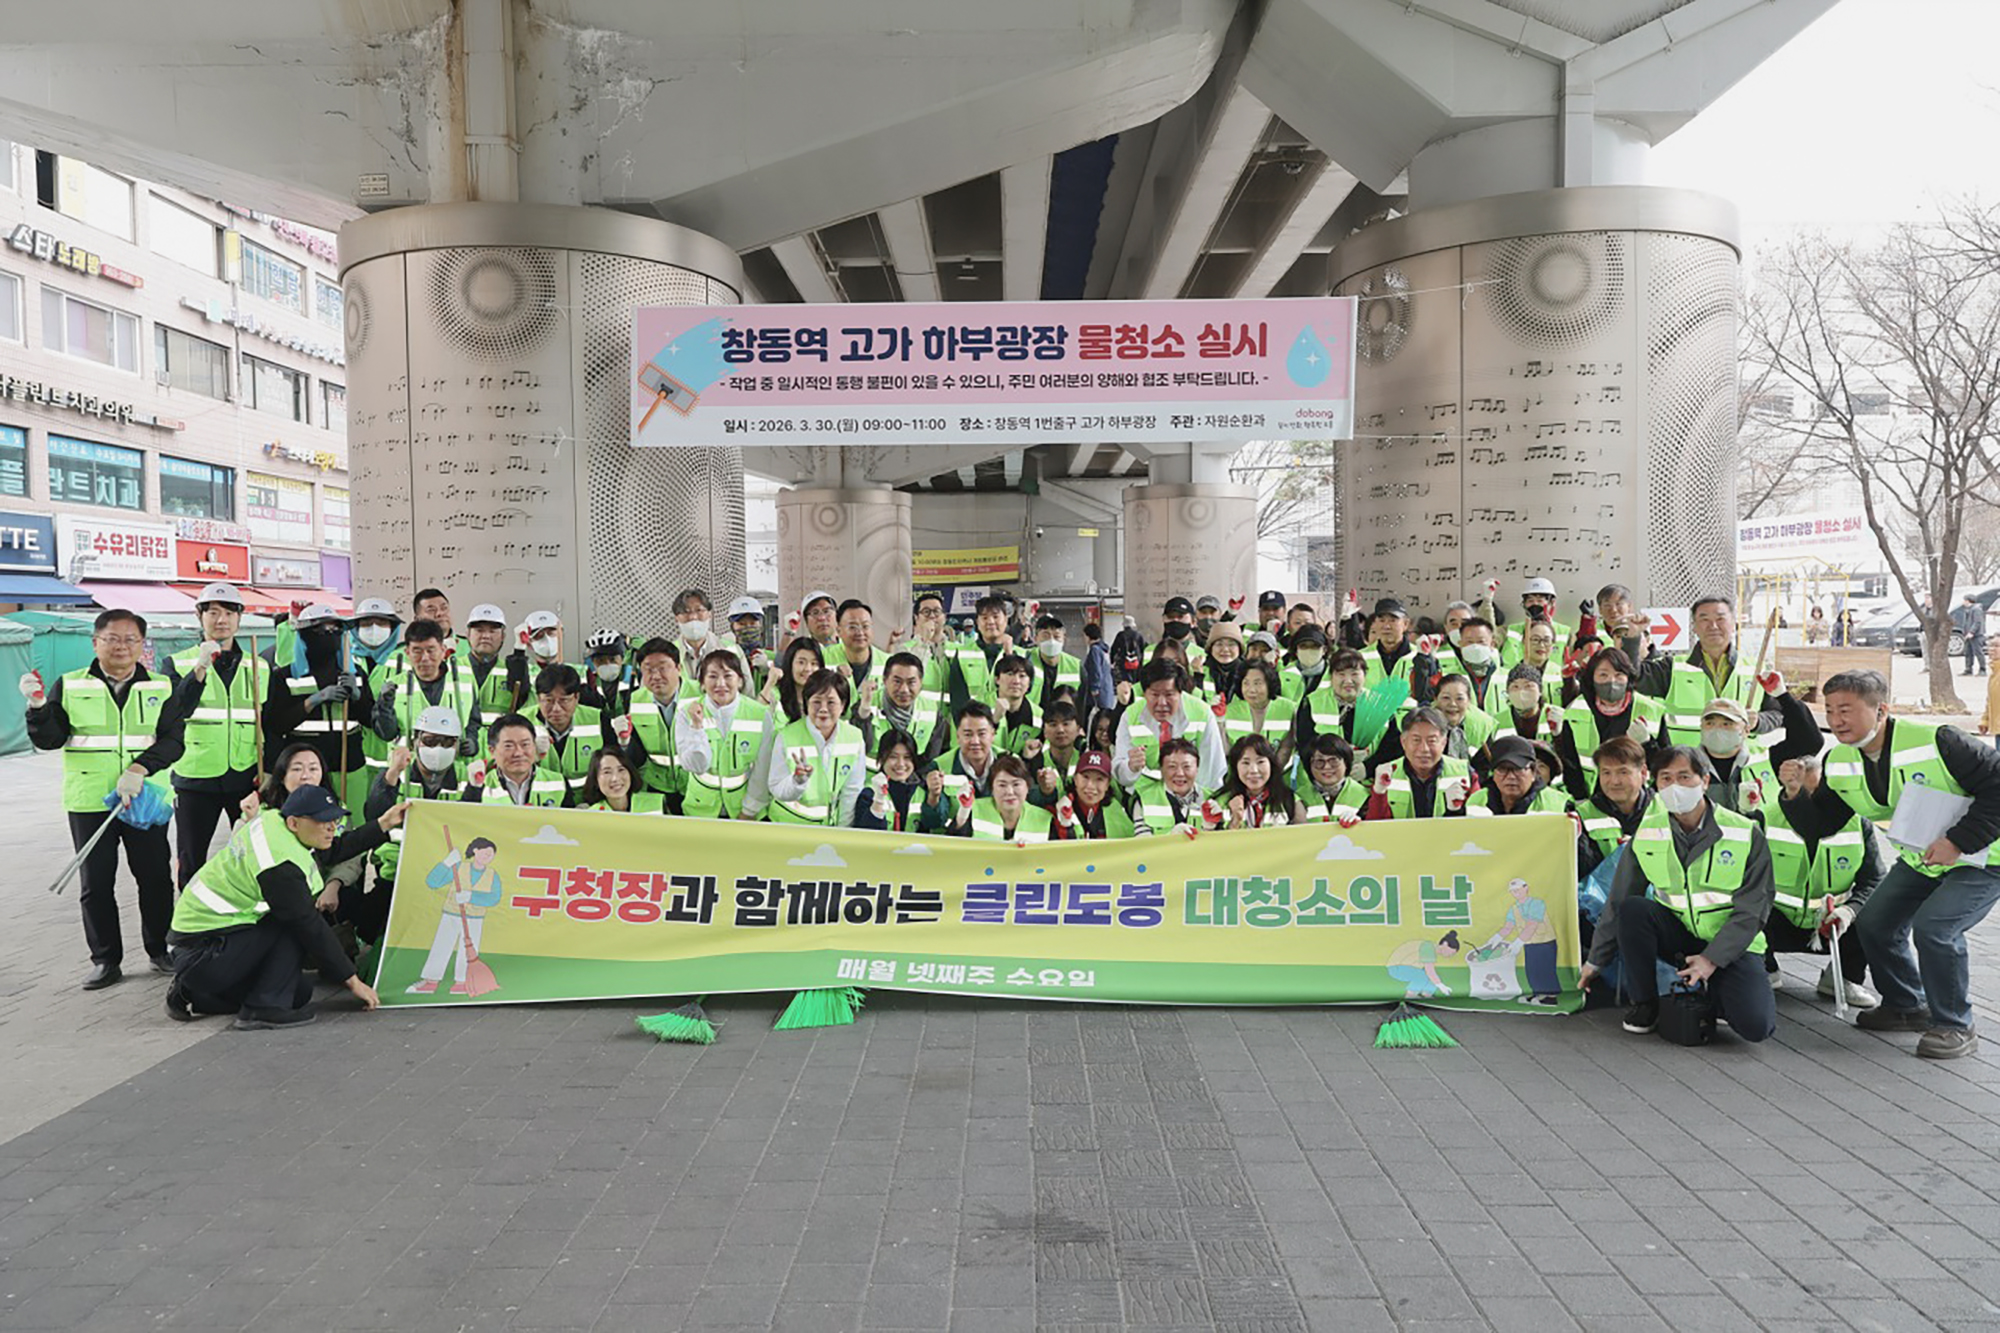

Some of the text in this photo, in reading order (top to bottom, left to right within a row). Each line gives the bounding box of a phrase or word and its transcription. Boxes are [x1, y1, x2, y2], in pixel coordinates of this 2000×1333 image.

[722, 322, 1267, 363] 창동역 고가 하부광장 물청소 실시
[729, 377, 757, 391] 작업
[760, 377, 774, 391] 중
[777, 376, 833, 391] 일시적인
[835, 376, 863, 390] 통행
[866, 376, 908, 390] 불편이
[911, 375, 938, 389] 있을
[942, 375, 956, 389] 수
[959, 374, 1005, 391] 있으니,
[1008, 374, 1036, 389] 주민
[1039, 374, 1094, 388] 여러분의
[1097, 373, 1139, 388] 양해와
[1142, 373, 1170, 387] 협조
[1173, 371, 1259, 387] 부탁드립니다.
[959, 417, 984, 432] 장소
[994, 416, 1031, 431] 창동역
[1034, 416, 1077, 431] 1번출구
[1081, 416, 1105, 430] 고가
[1108, 414, 1156, 429] 하부광장
[1170, 415, 1195, 429] 주관
[1204, 414, 1266, 428] 자원순환과
[1295, 408, 1334, 419] dobong
[723, 419, 748, 433] 일시
[759, 420, 796, 432] 2026.
[800, 420, 811, 432] 3.
[863, 418, 947, 431] 09:00~11:00
[1764, 525, 1779, 539] 고가
[1842, 516, 1862, 531] 실시
[93, 531, 169, 558] 수유리닭집
[511, 866, 1475, 927] 구청장과 함께하는 클린도봉 대청소의 날
[837, 958, 1096, 988] 매월 넷째주 수요일
